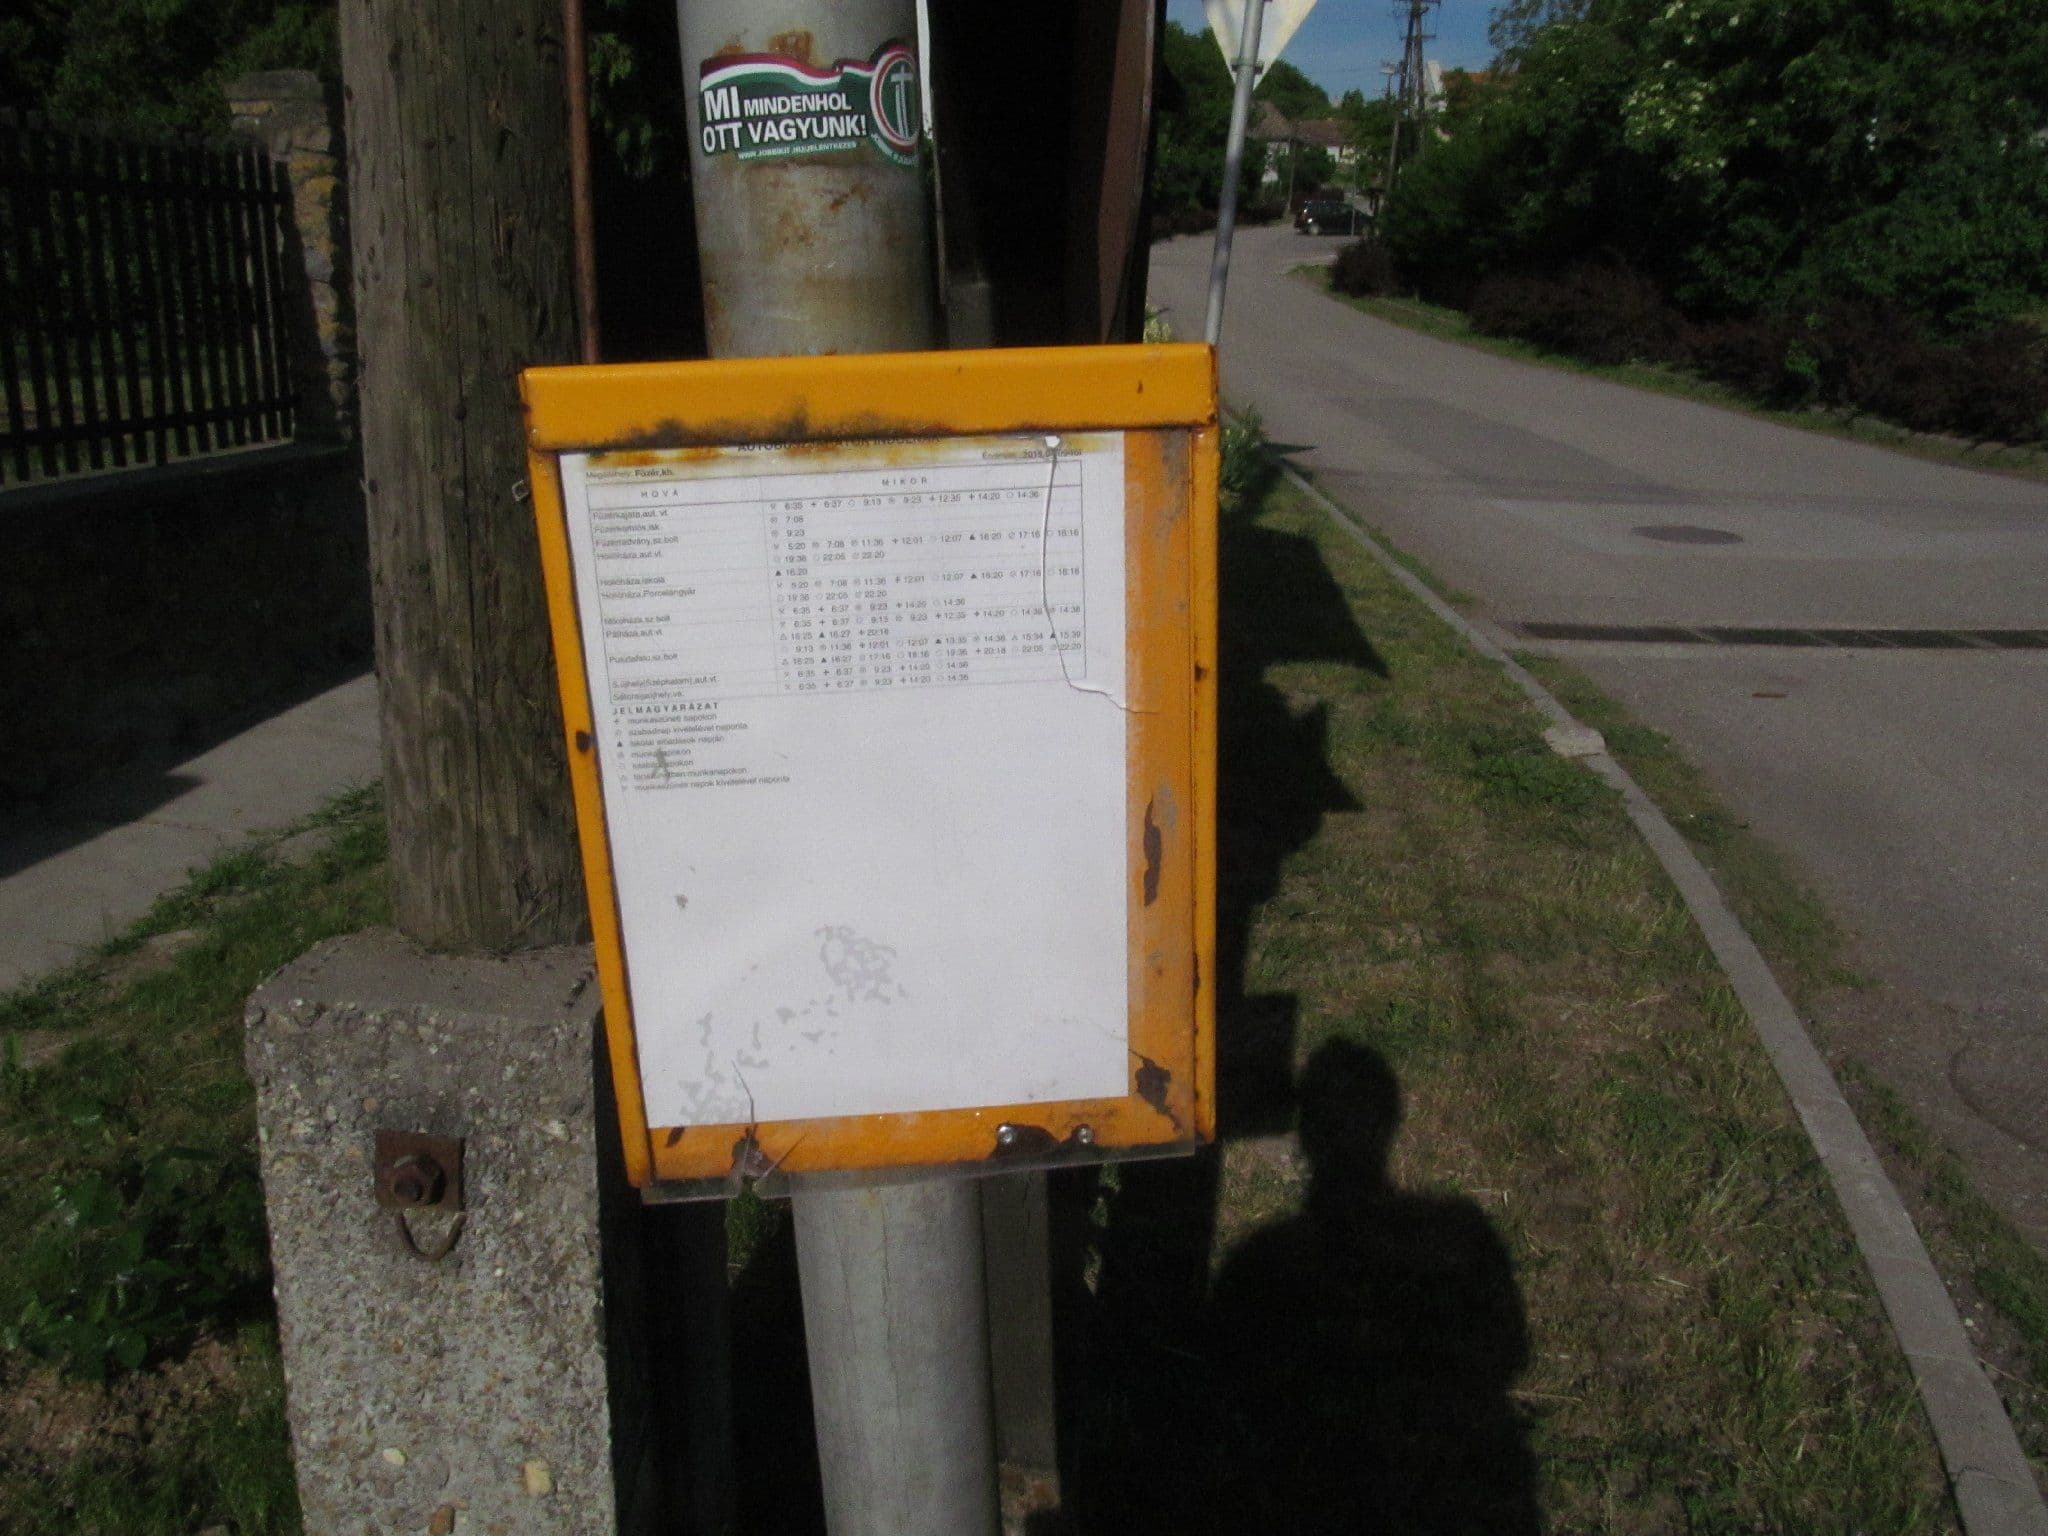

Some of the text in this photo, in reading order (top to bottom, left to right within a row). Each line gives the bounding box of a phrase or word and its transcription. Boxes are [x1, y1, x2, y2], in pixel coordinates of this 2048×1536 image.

[704, 86, 851, 121] MI MINDENHOL
[703, 115, 867, 153] OTT VAGYUNK!
